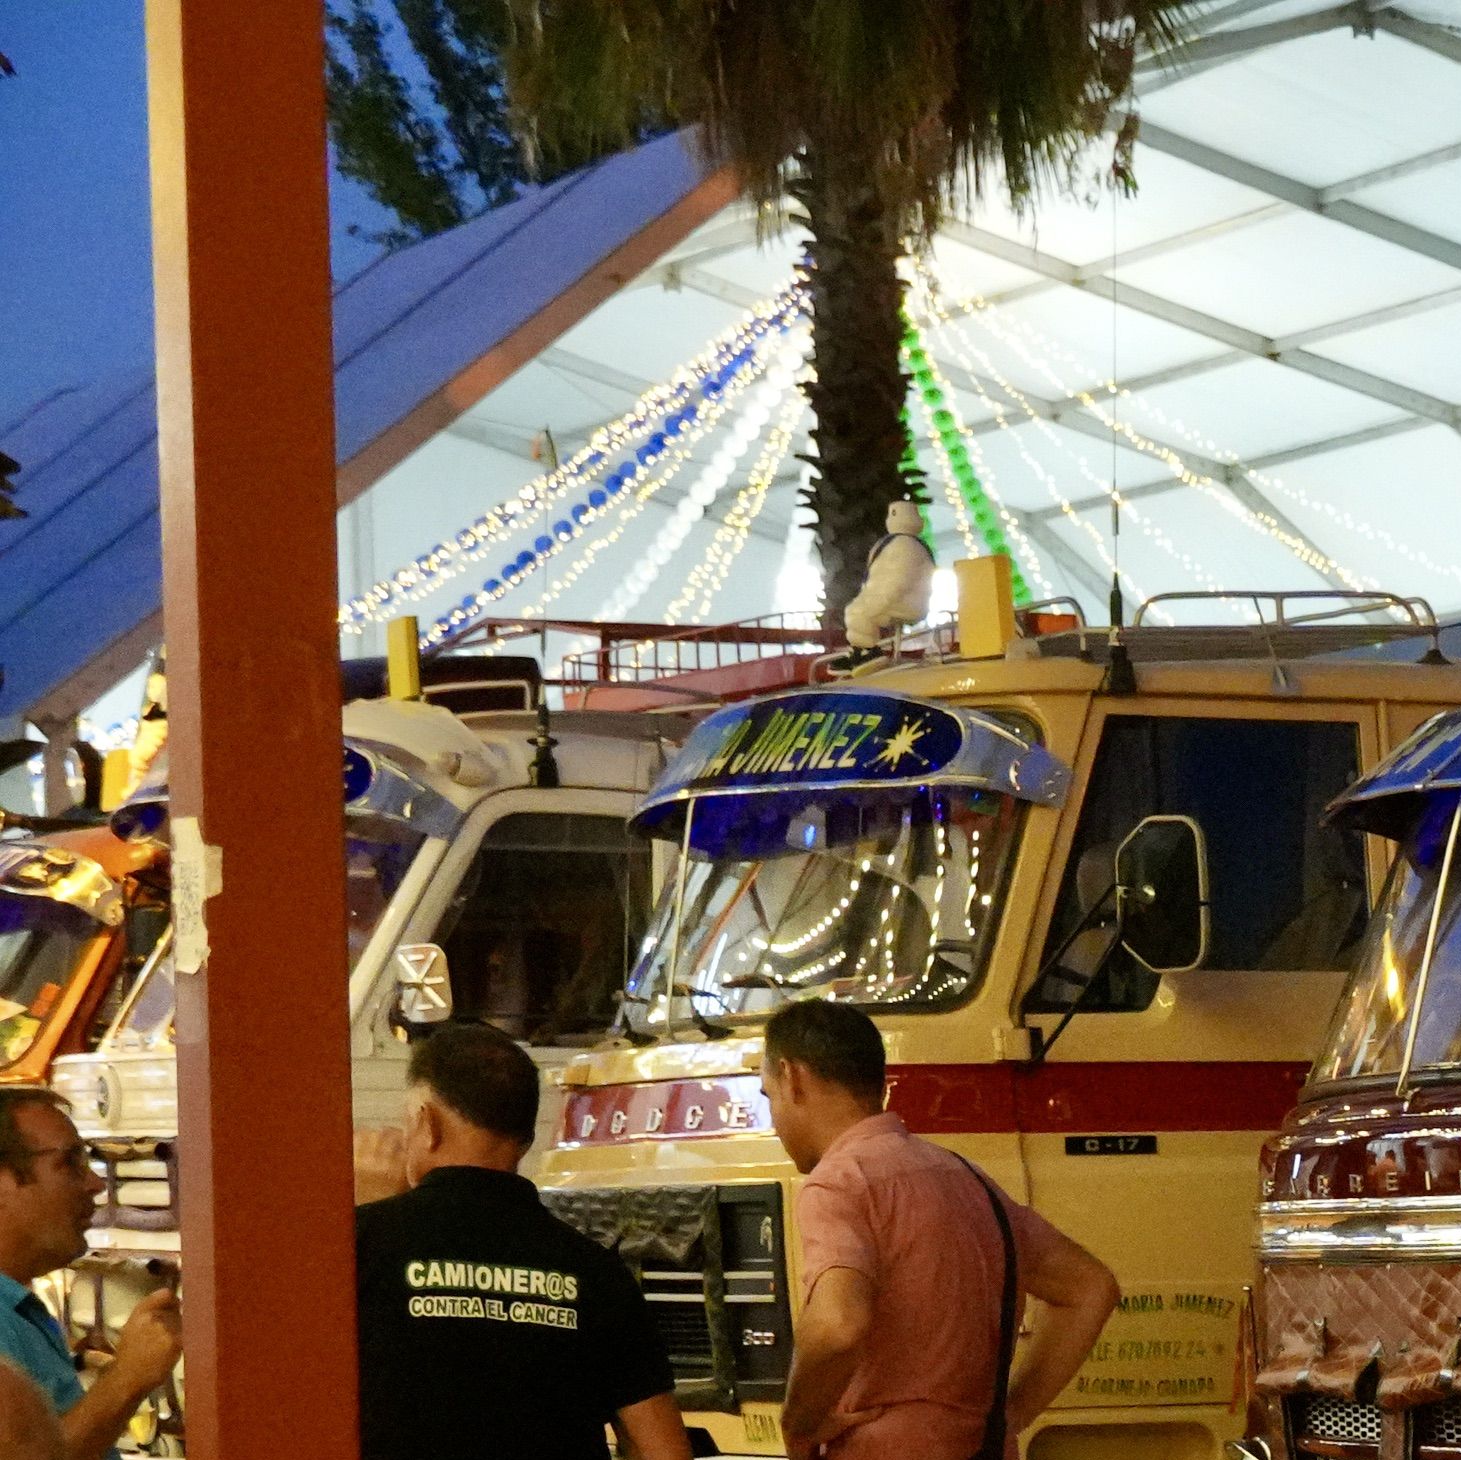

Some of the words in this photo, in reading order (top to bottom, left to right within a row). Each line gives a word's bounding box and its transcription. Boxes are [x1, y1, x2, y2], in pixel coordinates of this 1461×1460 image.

[728, 707, 883, 775] JIMENEZ
[580, 1101, 752, 1138] DODGE
[406, 1261, 578, 1301] CAMIONER@S
[409, 1296, 486, 1319] CONTRA
[485, 1299, 508, 1321] EL
[509, 1302, 578, 1330] CANCER
